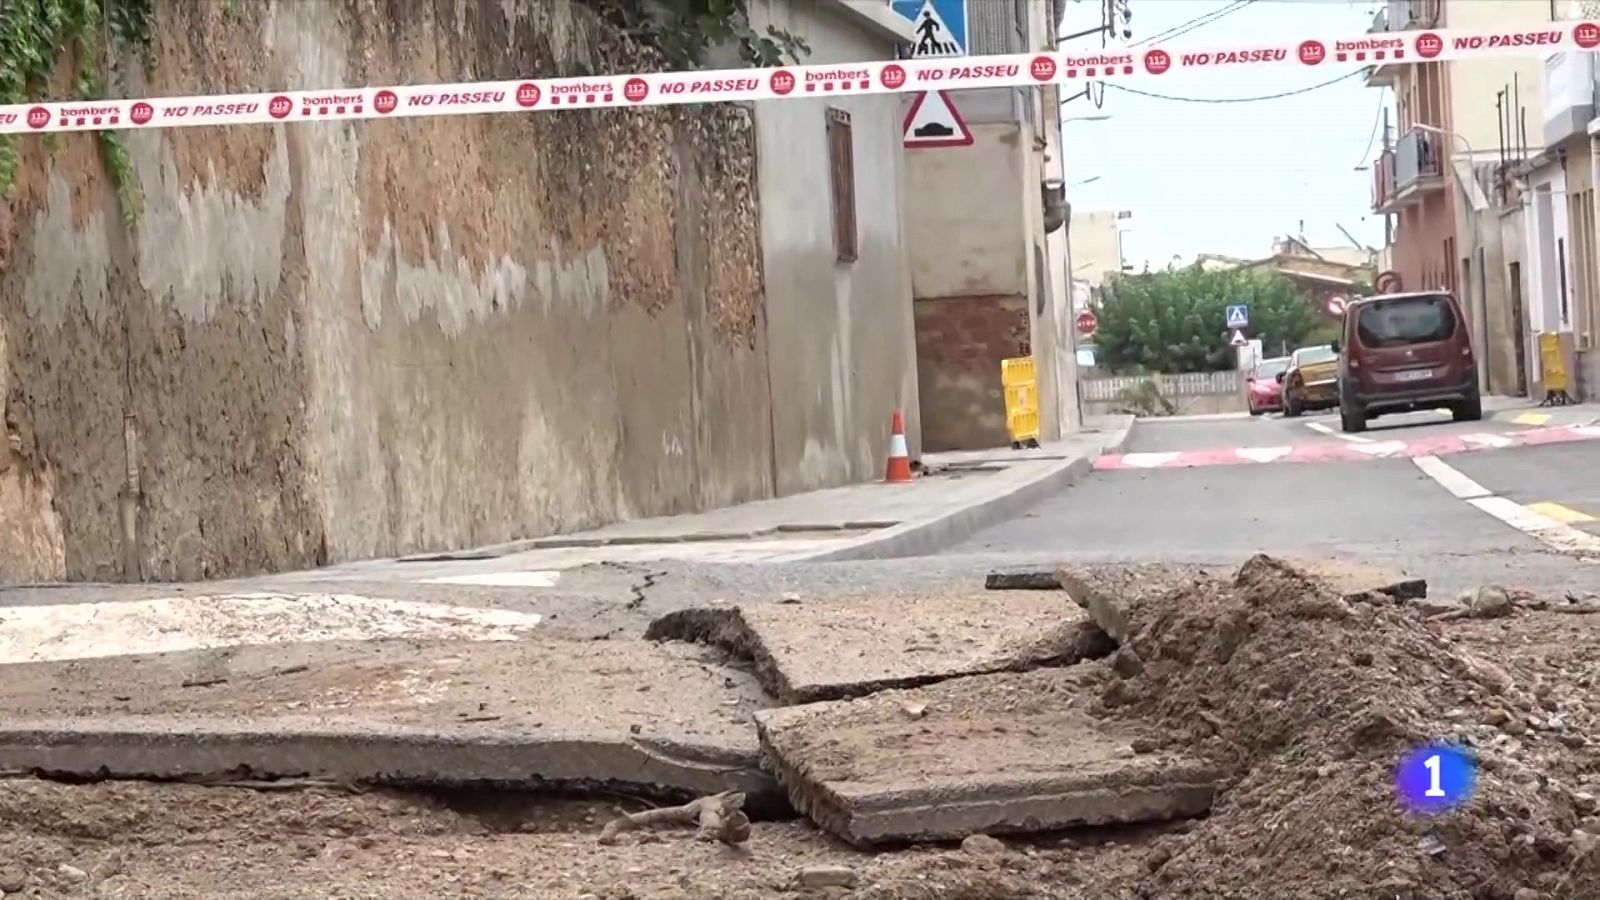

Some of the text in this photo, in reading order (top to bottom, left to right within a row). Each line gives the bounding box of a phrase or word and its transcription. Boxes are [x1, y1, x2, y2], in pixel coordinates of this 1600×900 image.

[32, 113, 46, 121] 112
[61, 106, 120, 117] bombers
[134, 107, 150, 117] 112
[164, 106, 188, 117] NO
[192, 103, 259, 116] PASSEU
[274, 101, 289, 112] 112
[302, 94, 363, 106] bombers
[379, 96, 393, 107] 112
[409, 95, 432, 106] NO
[438, 91, 505, 105] PASSEU
[520, 89, 536, 99] 112
[551, 82, 613, 94] bombers
[628, 84, 645, 95] 112
[660, 83, 684, 94] NO
[690, 79, 759, 92] PASSEU
[775, 77, 791, 87] 112
[806, 69, 870, 81] bombers
[884, 70, 902, 81] 112
[917, 69, 944, 81] NO
[950, 64, 1019, 79] PASSEU
[1035, 62, 1051, 73] 112
[1067, 53, 1133, 66] bombers
[1148, 56, 1167, 66] 112
[1182, 53, 1208, 66] NO
[1213, 49, 1287, 64] PASSEU
[1303, 46, 1321, 58] 112
[1335, 38, 1404, 51] bombers
[1420, 39, 1438, 50] 112
[1455, 37, 1481, 50] NO
[1488, 31, 1562, 48] PASSEU
[1579, 28, 1598, 39] 112
